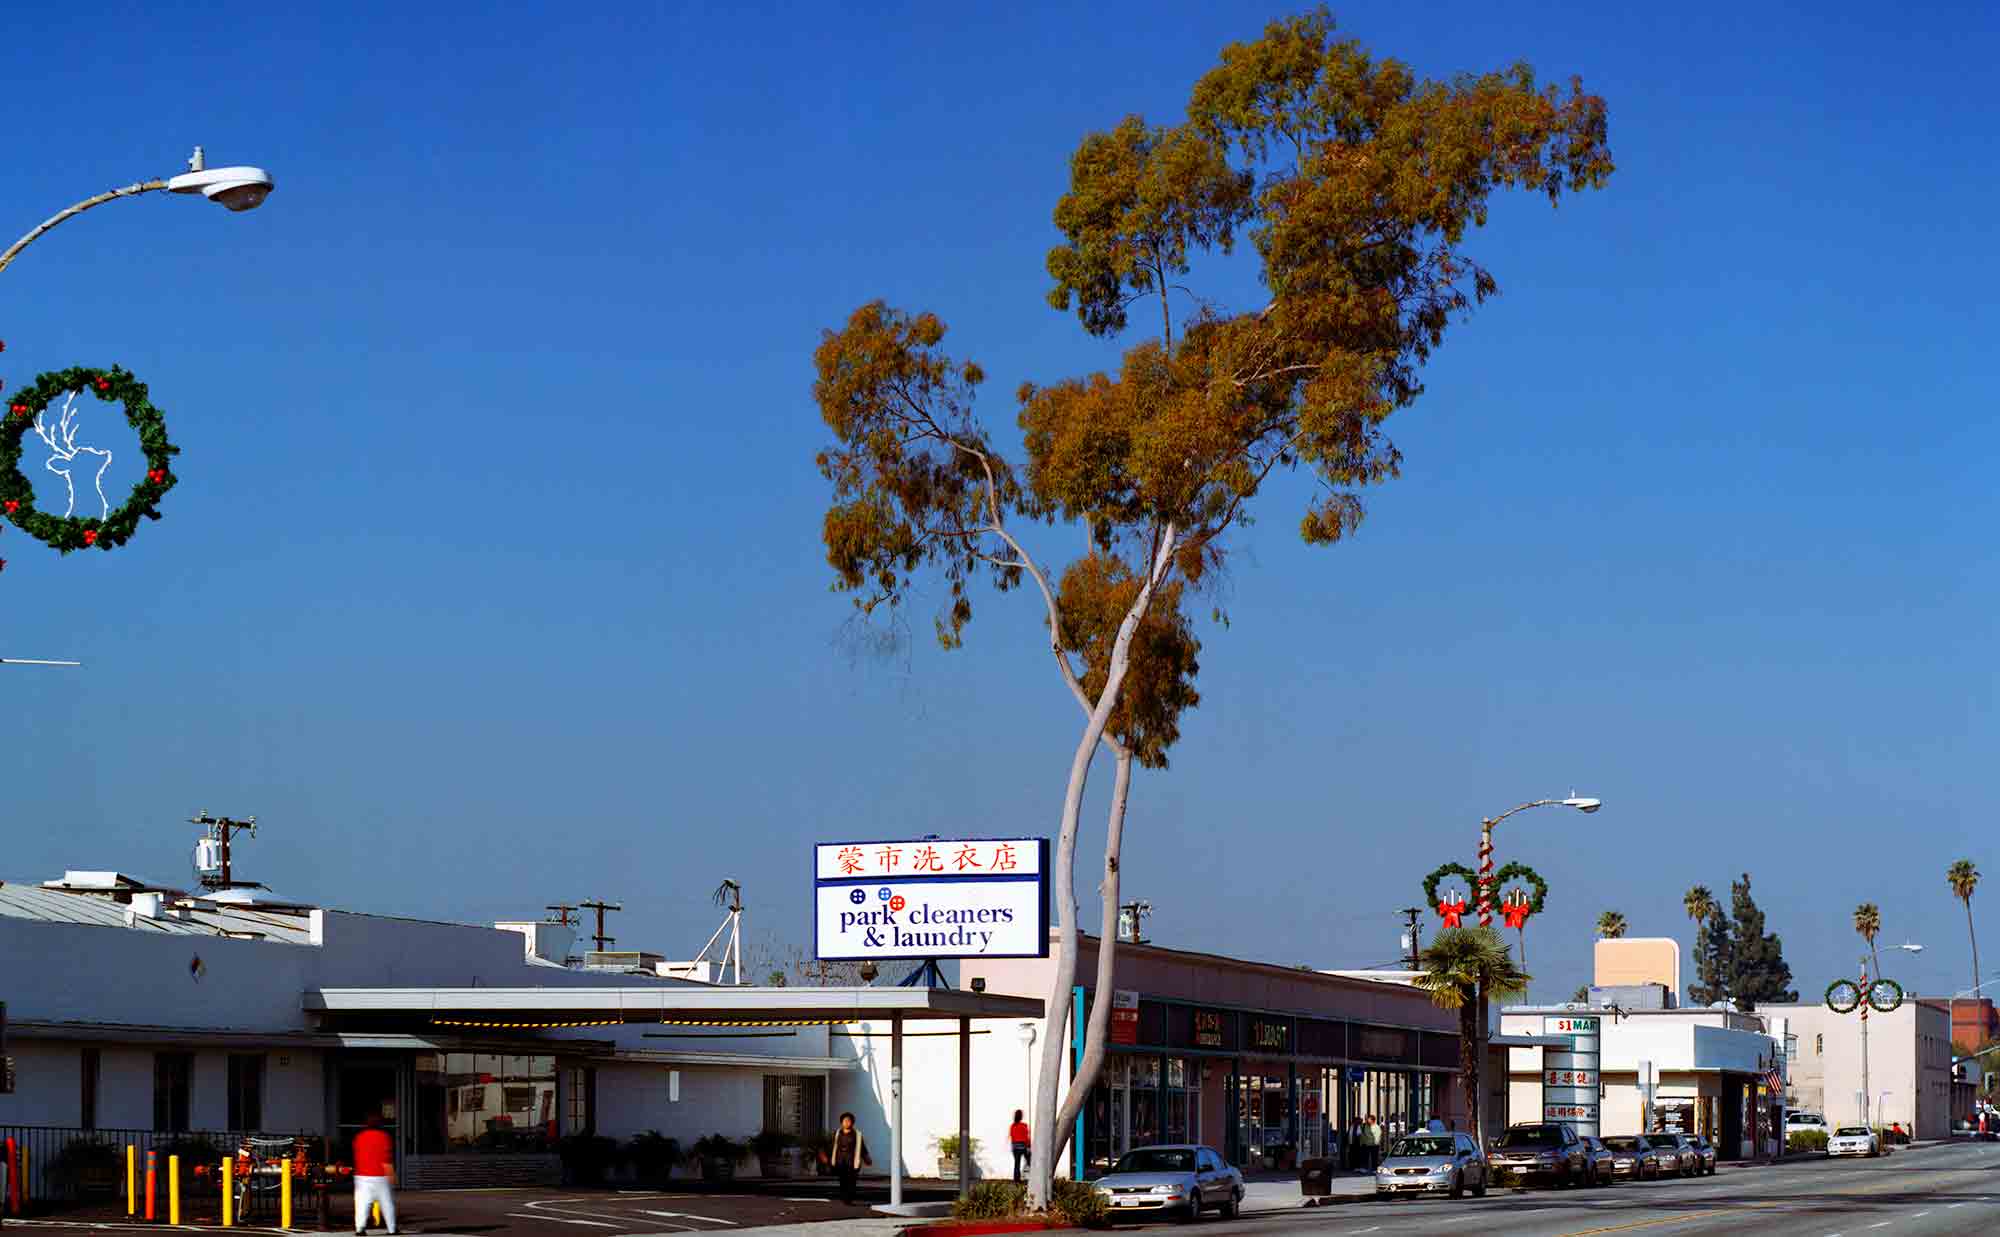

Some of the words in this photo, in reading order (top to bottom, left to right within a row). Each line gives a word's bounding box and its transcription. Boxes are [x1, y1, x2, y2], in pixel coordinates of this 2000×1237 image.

[837, 844, 1018, 875] 蒙市洗衣店
[840, 904, 896, 933] park
[909, 903, 1013, 925] cleaners
[863, 927, 886, 948] &
[893, 925, 993, 953] laundry
